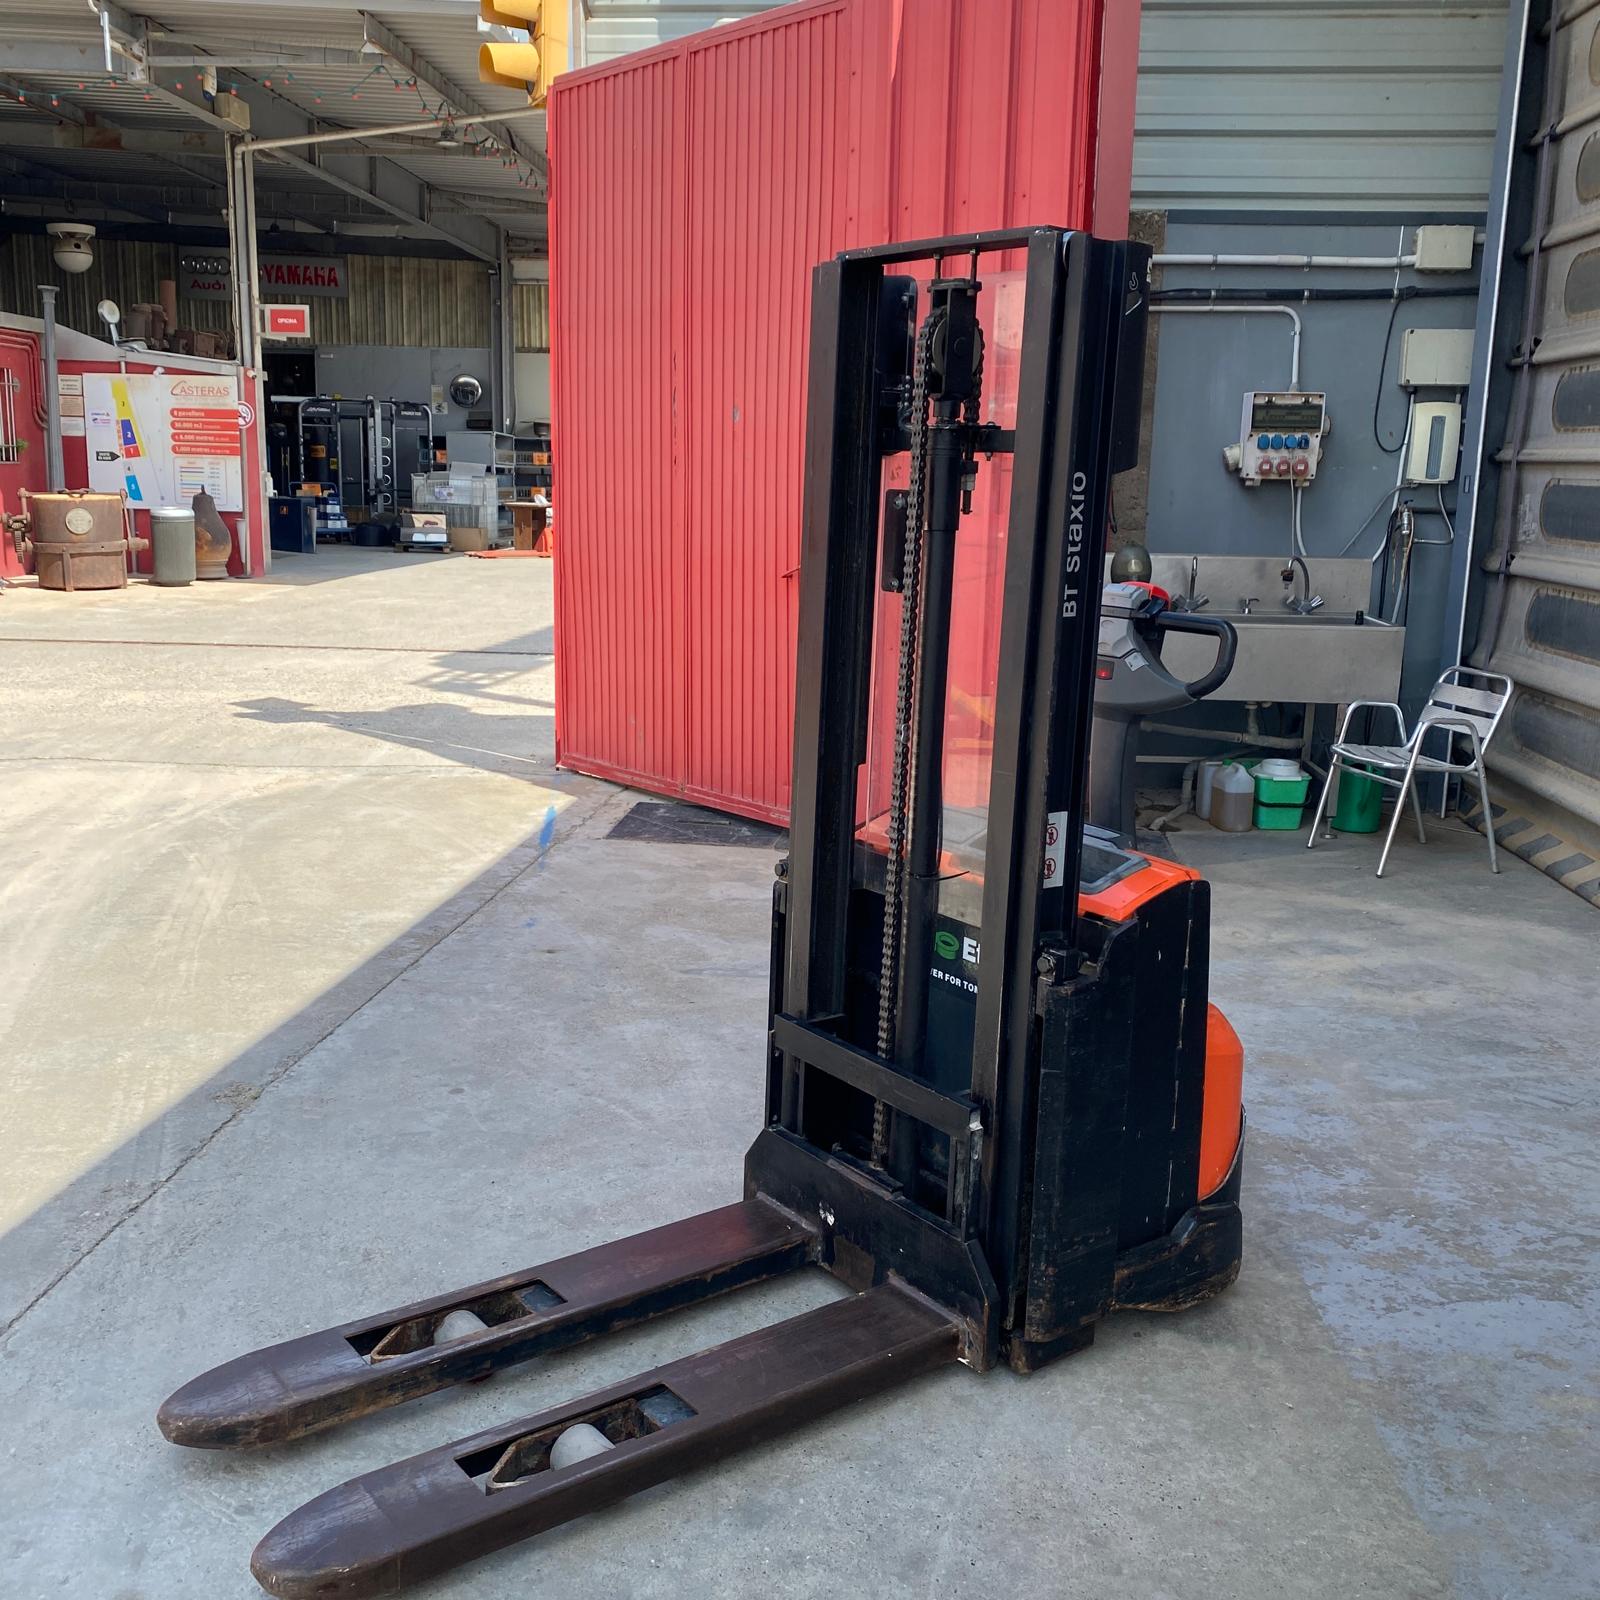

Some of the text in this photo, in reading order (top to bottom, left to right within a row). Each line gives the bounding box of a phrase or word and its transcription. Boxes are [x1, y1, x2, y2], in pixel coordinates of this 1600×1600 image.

[191, 279, 226, 291] Audi
[264, 264, 339, 287] YAMAHA
[277, 317, 298, 325] OFICINA
[1062, 583, 1079, 618] BT
[930, 967, 944, 980] ER
[944, 973, 962, 987] FOR
